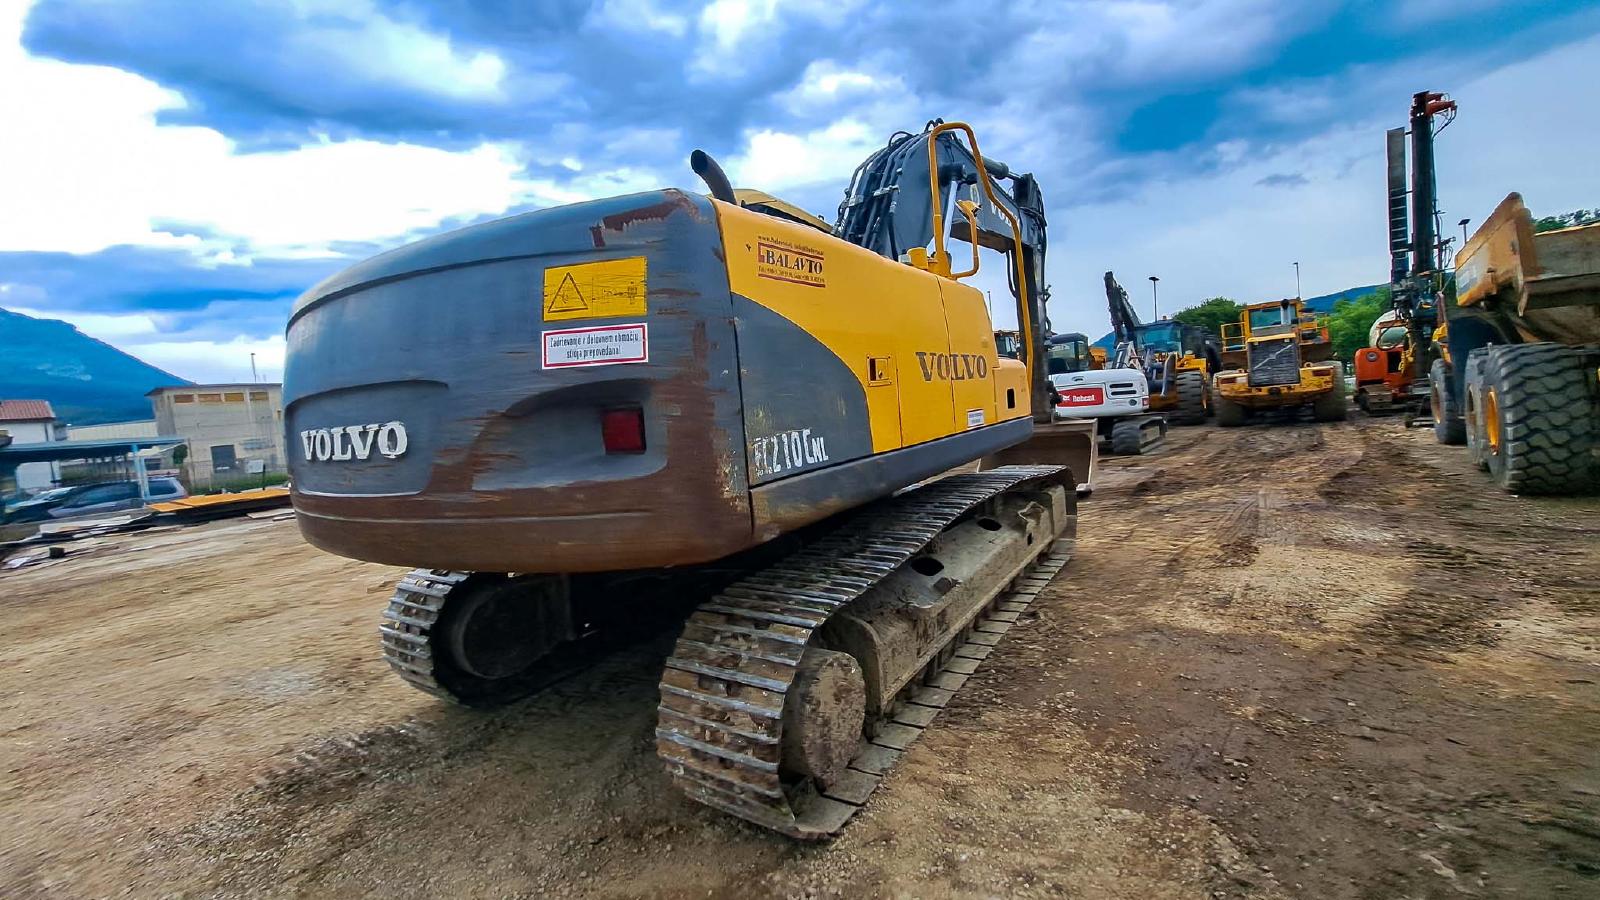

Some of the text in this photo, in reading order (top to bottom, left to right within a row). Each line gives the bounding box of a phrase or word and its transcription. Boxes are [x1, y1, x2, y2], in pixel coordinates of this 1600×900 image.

[766, 250, 823, 274] BALAVTO
[915, 352, 987, 381] VOLVO
[1072, 394, 1095, 403] Bobcat
[300, 421, 408, 461] VOLVO
